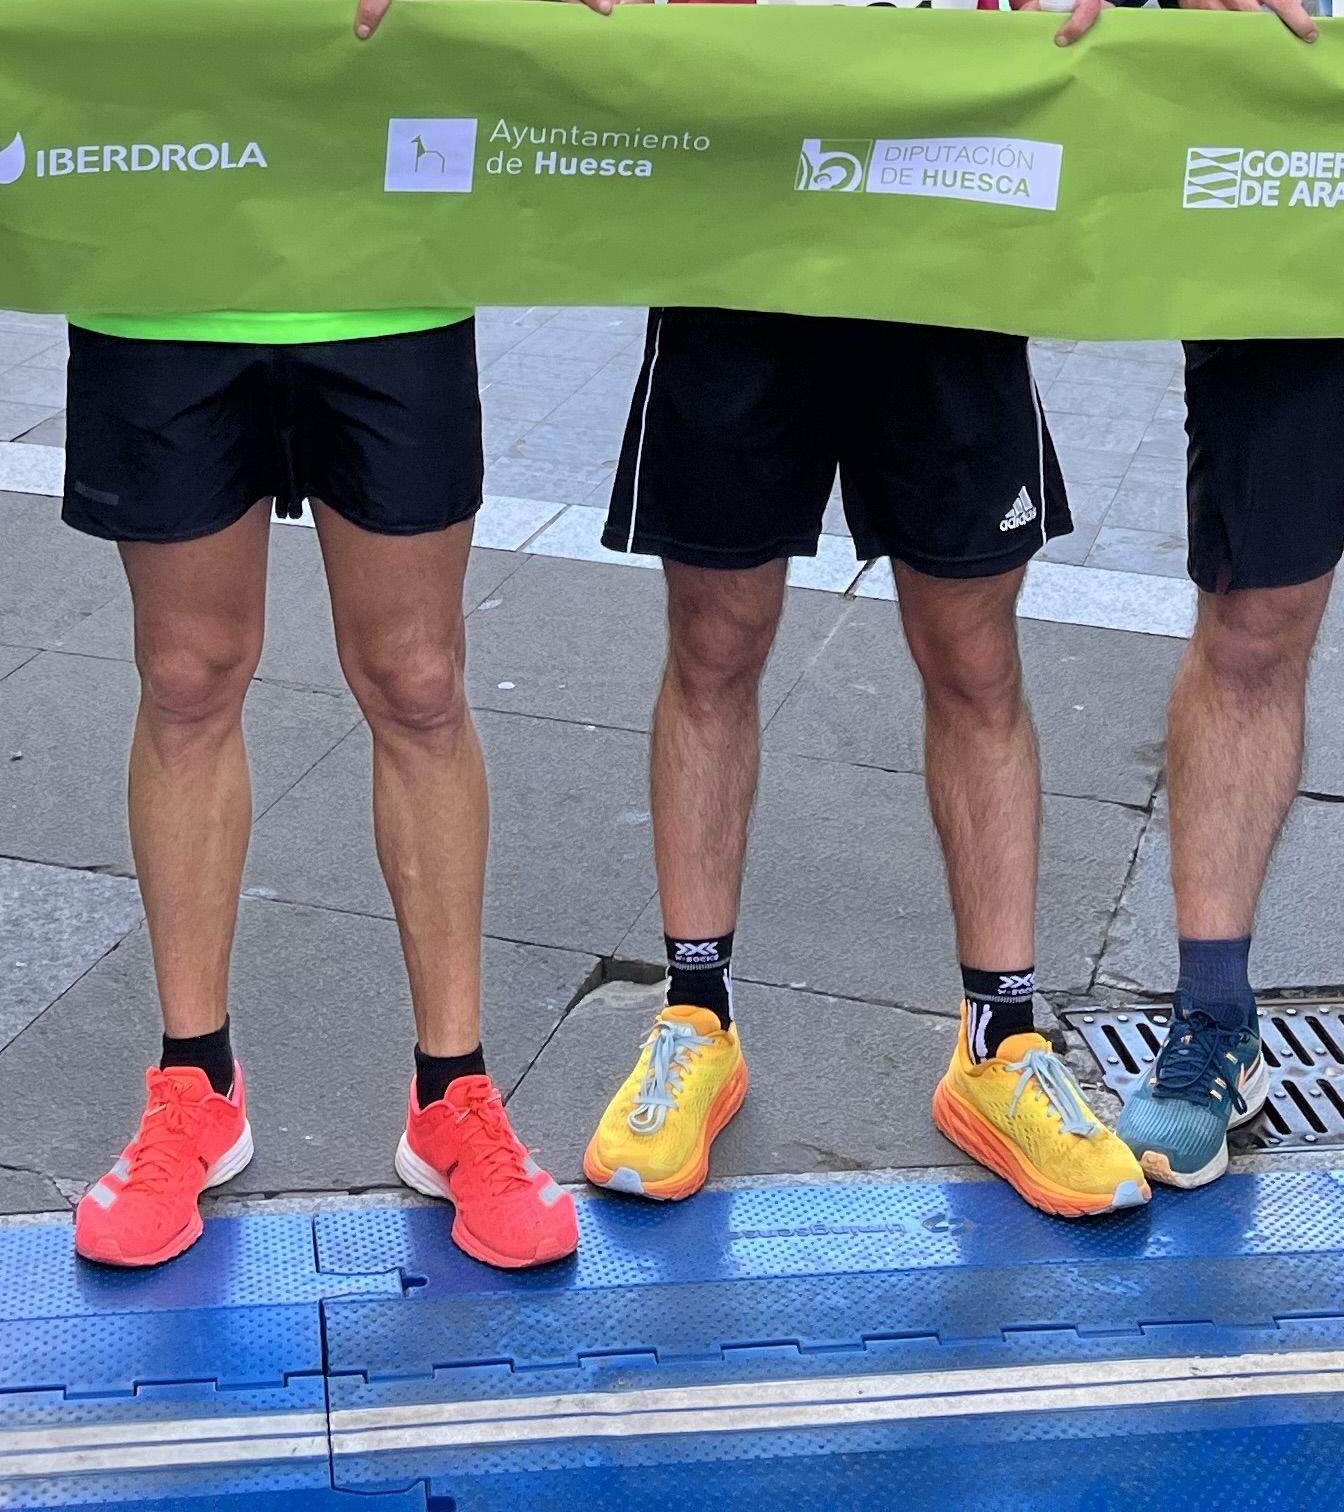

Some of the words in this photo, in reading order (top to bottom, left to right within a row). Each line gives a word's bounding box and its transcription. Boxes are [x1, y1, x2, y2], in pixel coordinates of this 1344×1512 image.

[489, 118, 711, 152] Ayuntamiento
[36, 141, 268, 178] IBERDROLA
[486, 150, 523, 175] de
[534, 150, 653, 177] Huesca
[884, 143, 1036, 172] DIPUTACIÓN
[880, 167, 913, 186] DE
[922, 168, 1031, 198] HUESCA
[1240, 180, 1280, 206] DE
[999, 506, 1037, 532] adidas
